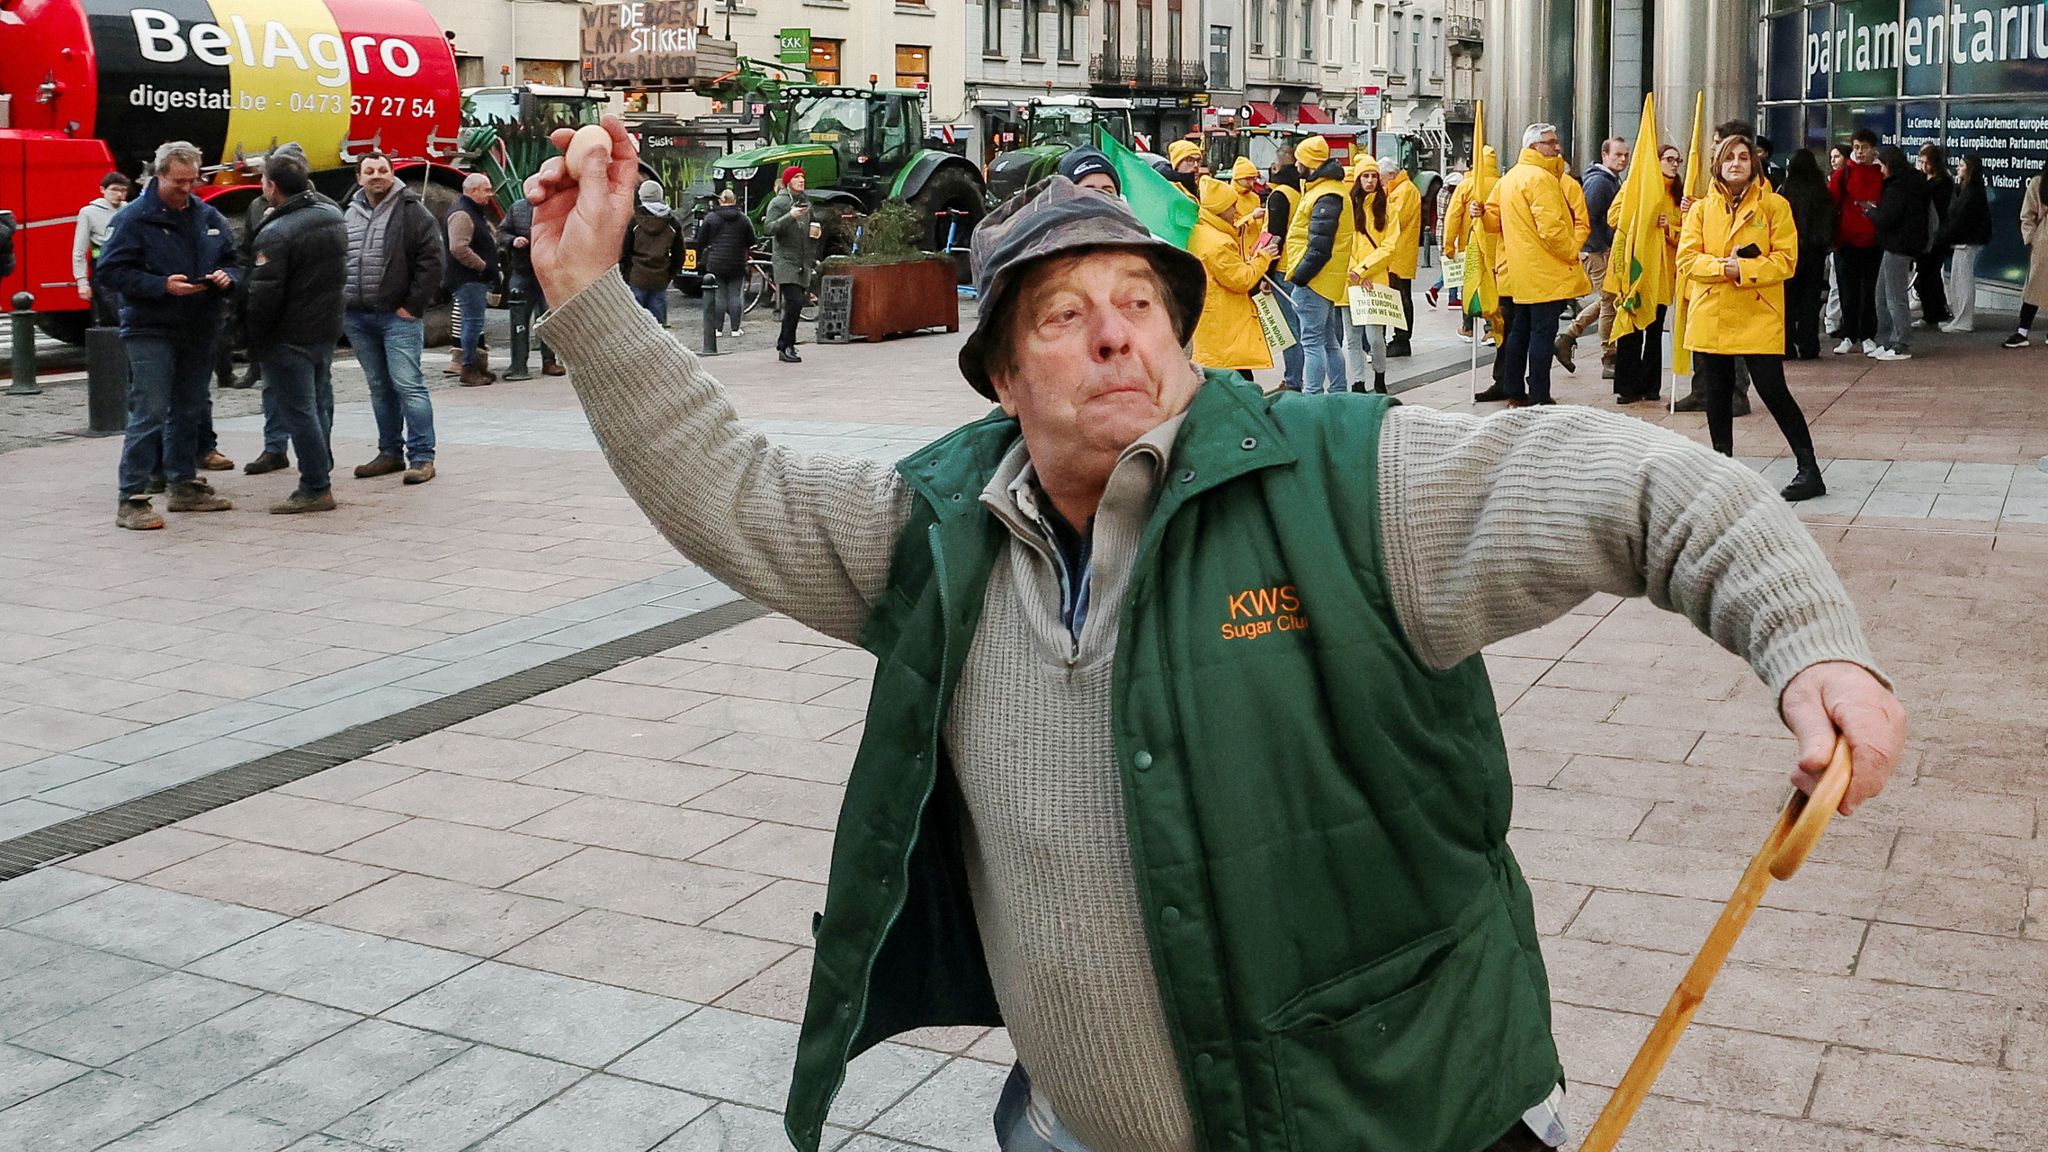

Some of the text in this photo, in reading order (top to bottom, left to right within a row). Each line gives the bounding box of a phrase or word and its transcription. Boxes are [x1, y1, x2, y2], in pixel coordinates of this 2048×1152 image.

[582, 4, 620, 28] WIE
[620, 3, 645, 29] DE
[130, 8, 421, 88] BelAgro
[580, 29, 629, 55] LAAT
[129, 84, 267, 112] digestat.be
[289, 92, 343, 114] 0473
[350, 95, 375, 115] 57
[381, 97, 406, 116] 27
[411, 98, 436, 118] 54
[1914, 117, 1934, 129] Centre
[1947, 117, 1974, 129] visiteurs
[1983, 117, 2019, 130] Parlement
[1947, 136, 1959, 148] des
[1960, 136, 2008, 151] Europäischen
[1227, 585, 1300, 620] KWS
[1221, 620, 1273, 640] Sugar
